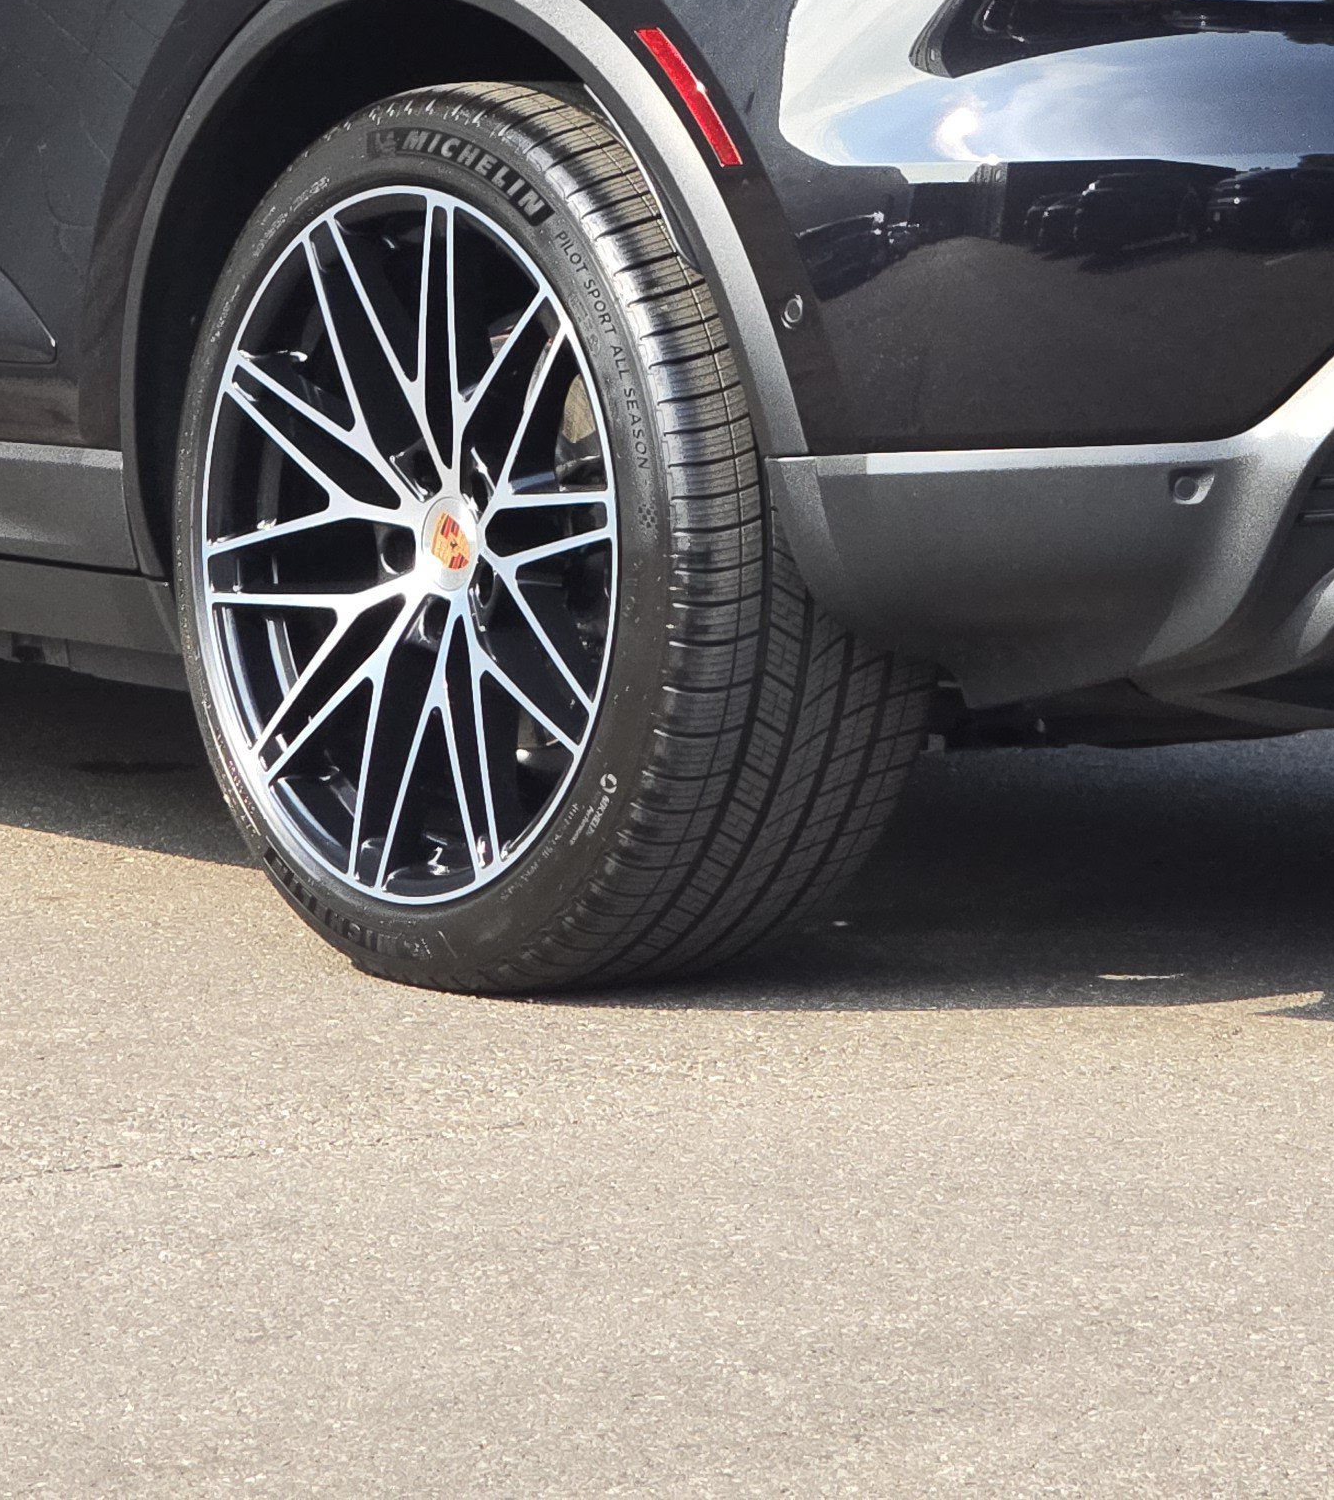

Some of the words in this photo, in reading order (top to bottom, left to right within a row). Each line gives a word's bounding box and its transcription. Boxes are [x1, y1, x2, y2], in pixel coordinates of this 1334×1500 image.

[401, 129, 546, 218] MICHELIN
[555, 230, 589, 277] PILOT
[583, 278, 618, 336] SPORT
[610, 343, 631, 382] ALL
[623, 386, 651, 471] SEASON
